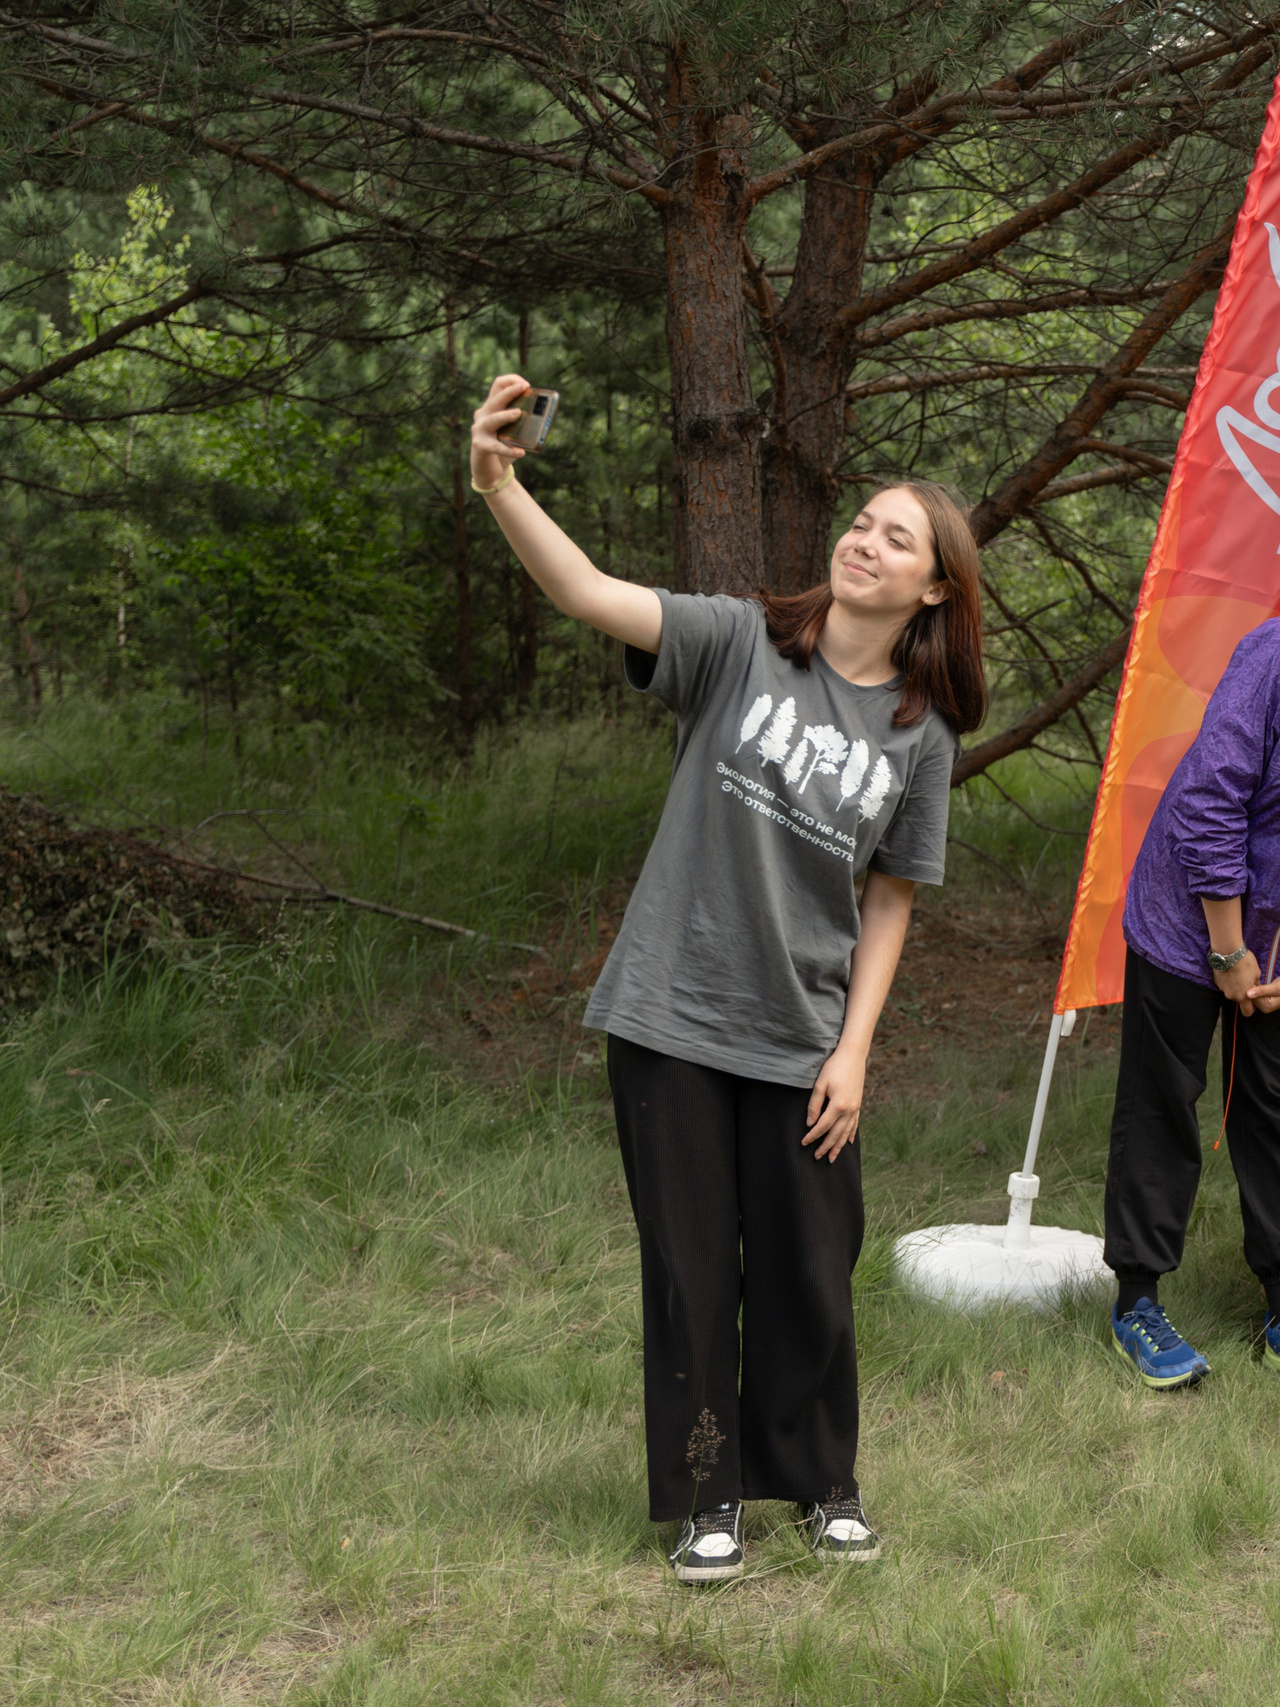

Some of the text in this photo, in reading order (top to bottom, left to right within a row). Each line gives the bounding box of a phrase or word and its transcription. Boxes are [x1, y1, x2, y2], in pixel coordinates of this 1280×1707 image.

[717, 762, 776, 801] Экология
[790, 808, 815, 826] это
[815, 822, 834, 836] не
[721, 780, 744, 800] Это
